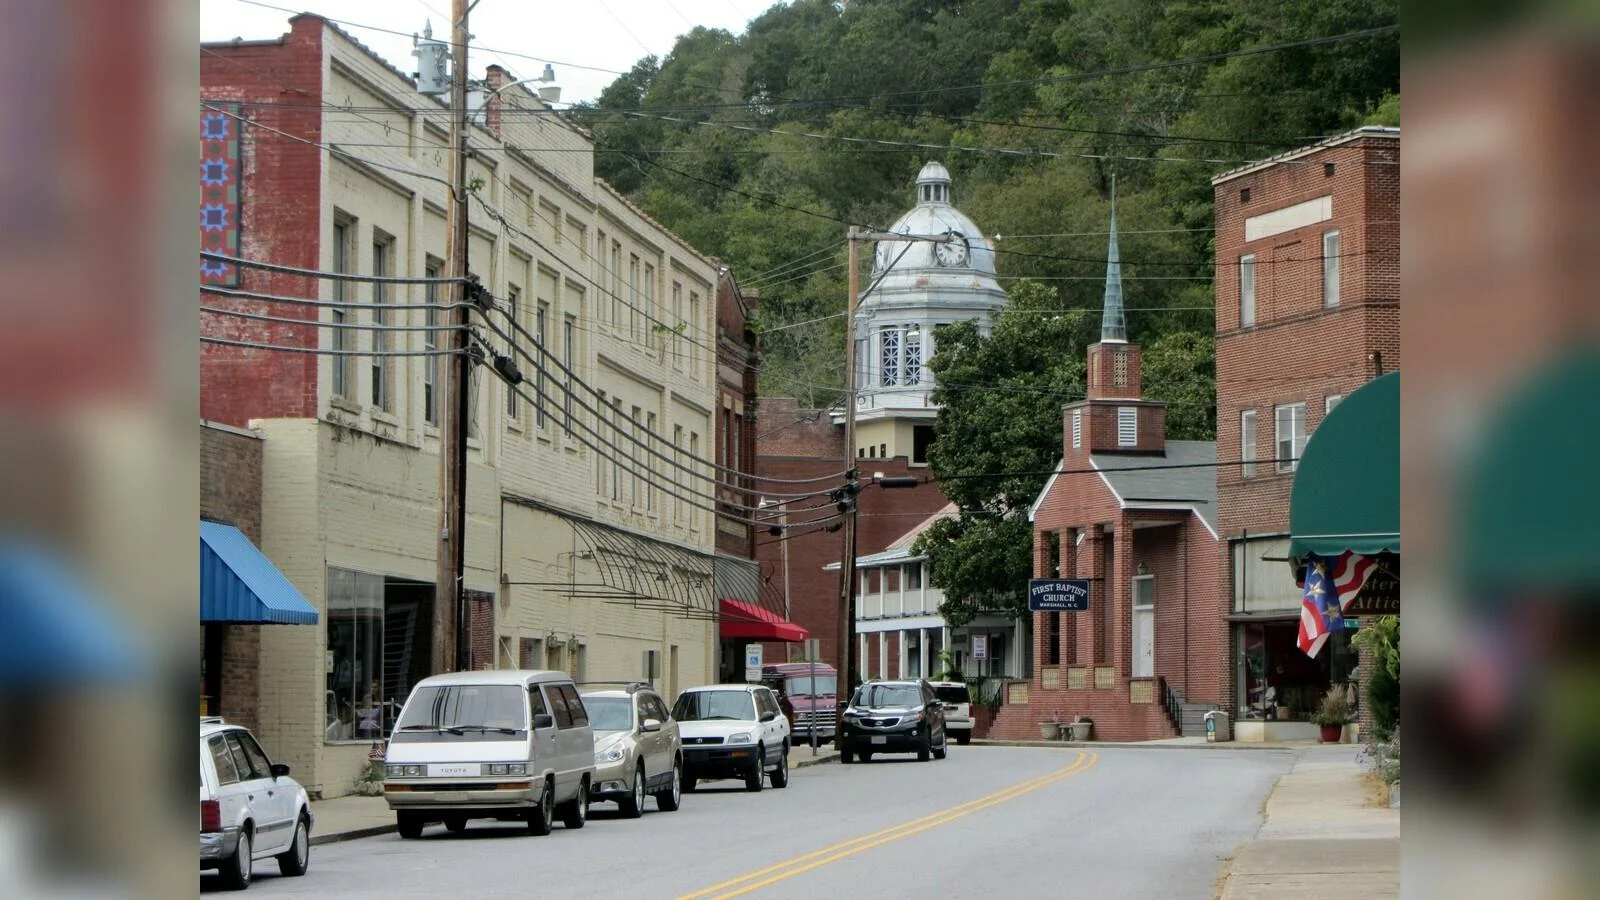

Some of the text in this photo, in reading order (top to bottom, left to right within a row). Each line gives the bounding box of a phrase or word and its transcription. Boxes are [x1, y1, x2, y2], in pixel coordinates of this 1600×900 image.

[1032, 583, 1087, 597] FIRST BAPTIST
[1043, 594, 1075, 602] CHURCH
[1352, 596, 1399, 609] Attic
